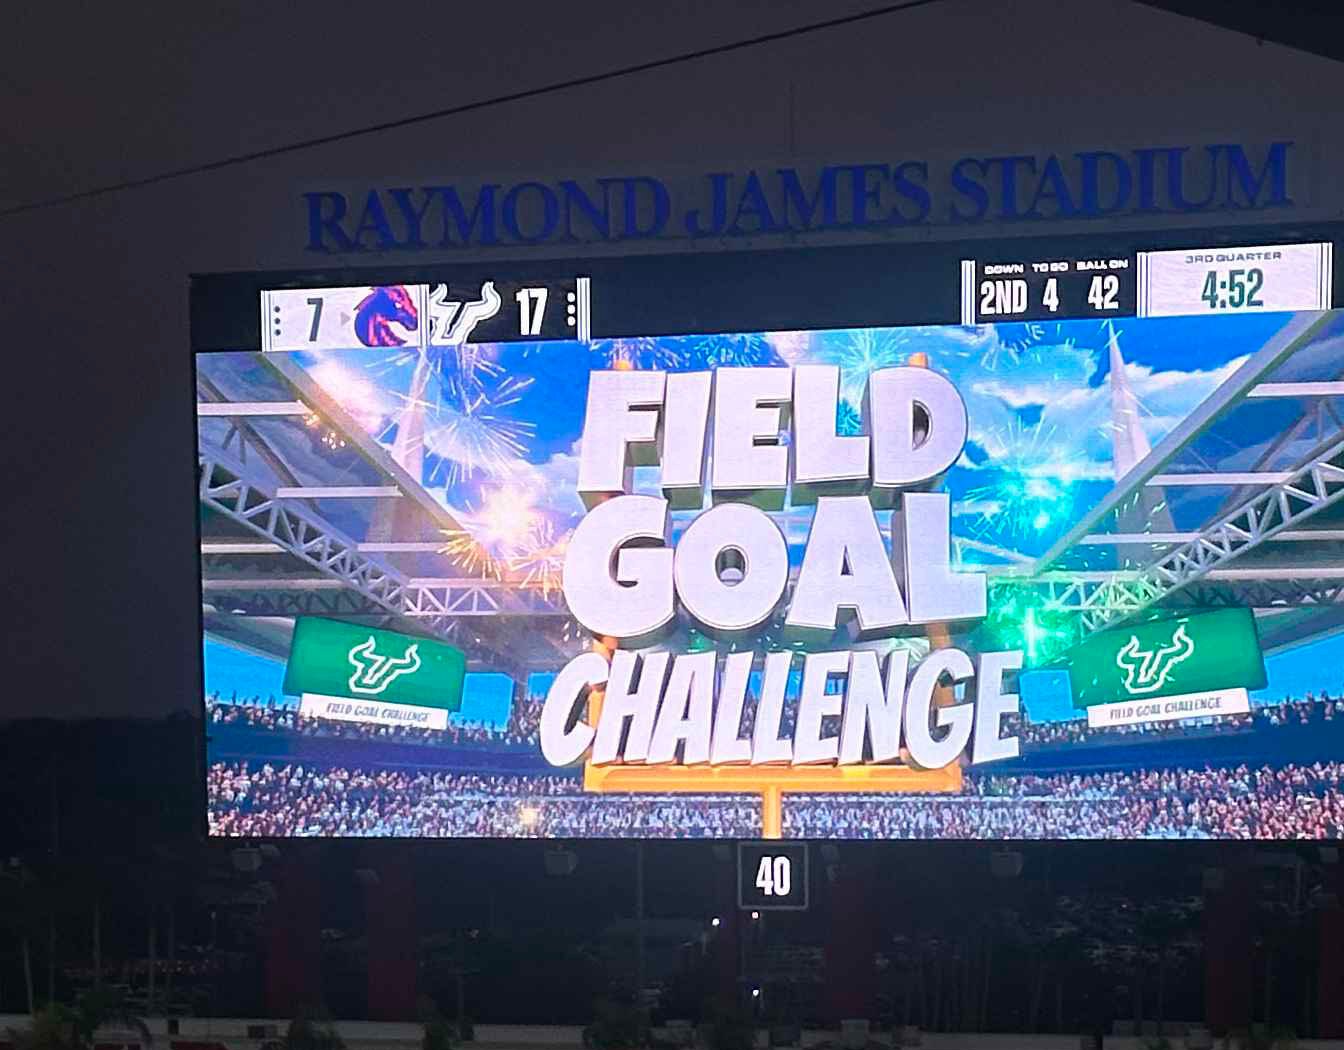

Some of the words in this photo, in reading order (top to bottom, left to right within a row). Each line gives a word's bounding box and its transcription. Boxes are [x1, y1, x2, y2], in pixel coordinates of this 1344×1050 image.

[304, 176, 670, 252] RAYMOND
[685, 160, 930, 236] JAMES
[951, 141, 1295, 222] STADIUM
[985, 263, 1024, 275] DOWN
[1032, 262, 1047, 273] TO
[1076, 260, 1107, 271] BALL
[1109, 259, 1128, 270] ON
[1185, 254, 1215, 265] 3RD
[1216, 251, 1282, 263] QUARTER
[980, 278, 1027, 314] 2ND
[1042, 278, 1059, 312] 4
[1087, 275, 1119, 309] 42
[1201, 269, 1263, 309] 4:52
[307, 297, 323, 341] 7
[515, 287, 549, 336] 17
[577, 365, 969, 502] FIELD
[563, 492, 987, 636] GOAL
[539, 651, 1023, 770] CHALLENGE
[1165, 696, 1222, 714] CHALLENGE
[755, 857, 791, 895] 40
